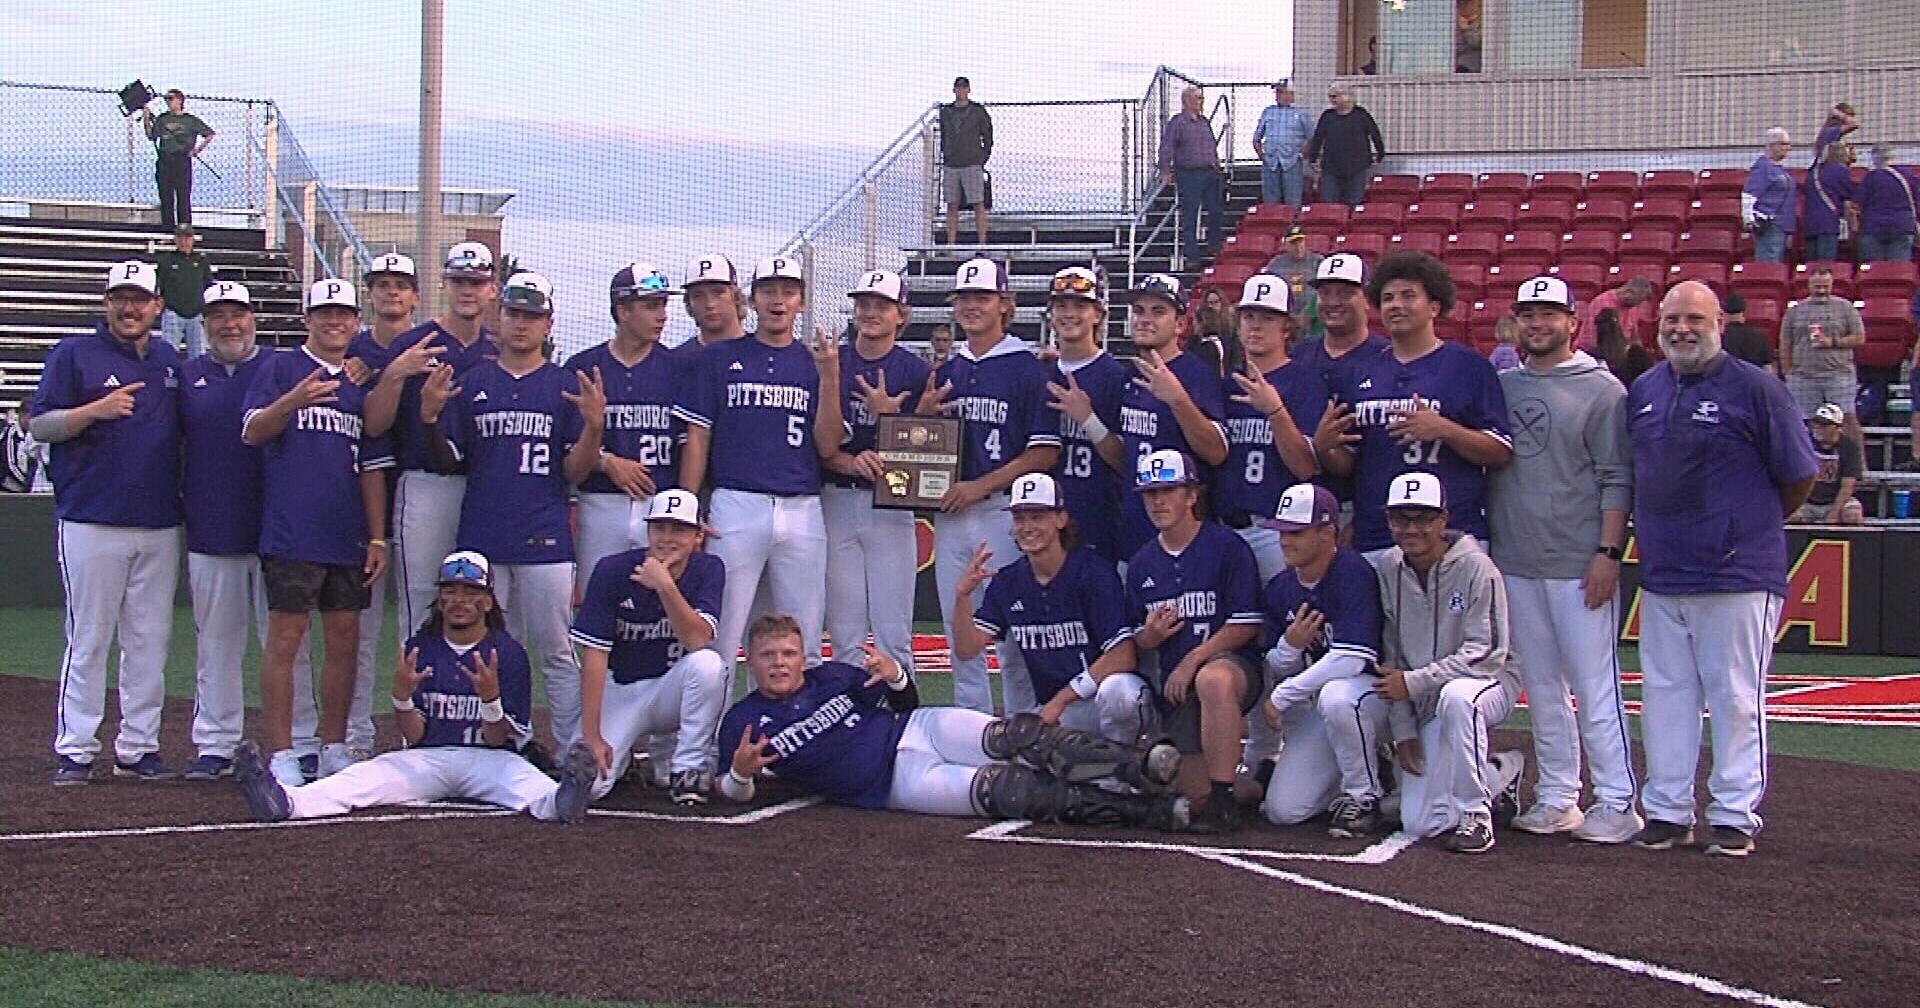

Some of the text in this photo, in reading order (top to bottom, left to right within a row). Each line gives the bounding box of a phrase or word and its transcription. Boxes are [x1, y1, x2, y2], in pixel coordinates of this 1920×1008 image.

[124, 264, 140, 280] P
[699, 260, 712, 277] P
[773, 259, 786, 275] P
[964, 266, 979, 284] P
[1328, 258, 1344, 275] P
[867, 273, 884, 287] P
[1531, 280, 1548, 298] P
[220, 284, 233, 298] P
[326, 283, 341, 299] P
[1254, 284, 1271, 301] P
[787, 414, 805, 448] 5
[639, 434, 672, 466] 20
[984, 428, 1001, 460] 4
[1403, 440, 1443, 464] 37
[520, 442, 550, 475] 12
[1064, 444, 1092, 478] 13
[1152, 458, 1164, 477] P
[1245, 451, 1265, 483] 8
[1021, 480, 1035, 499] P
[1403, 480, 1420, 499] P
[665, 496, 682, 514] P
[1278, 496, 1292, 515] P
